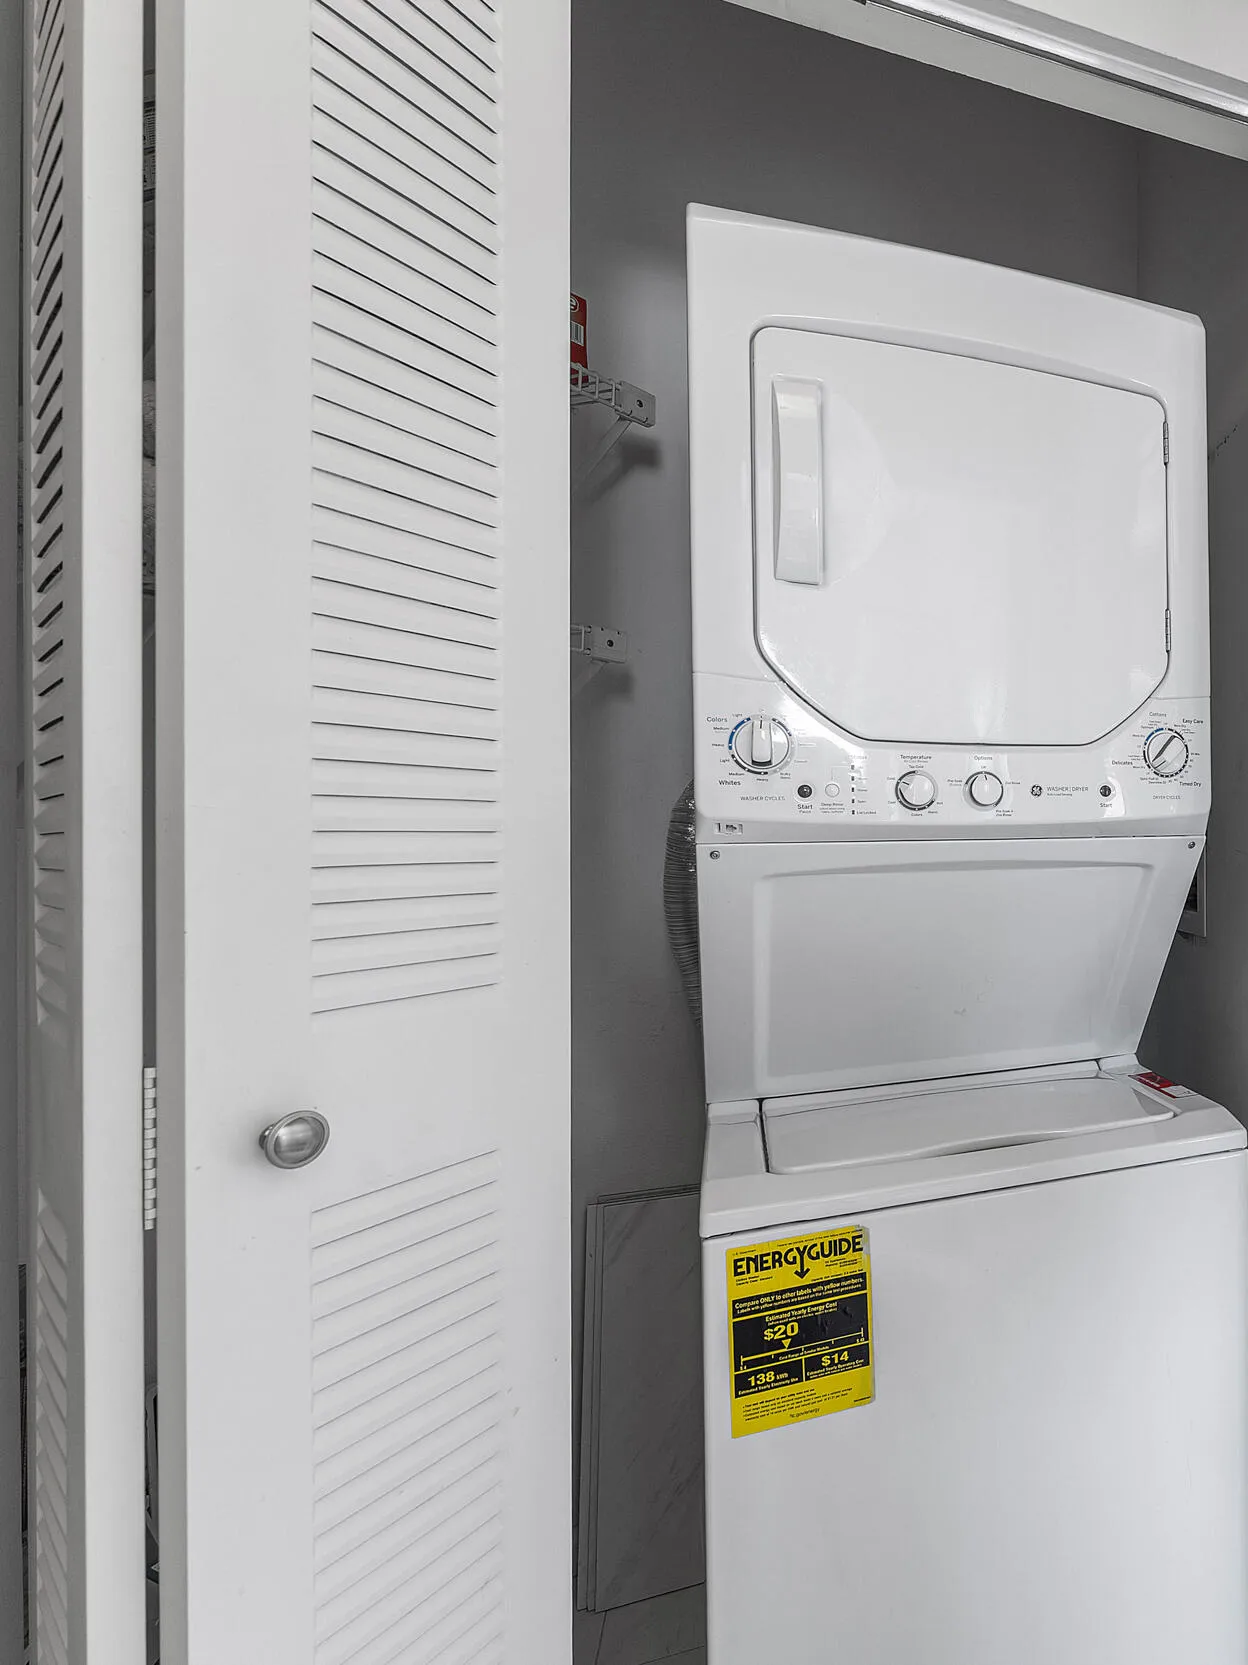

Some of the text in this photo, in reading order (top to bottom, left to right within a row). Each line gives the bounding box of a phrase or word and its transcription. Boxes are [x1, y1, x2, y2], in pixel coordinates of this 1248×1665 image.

[706, 716, 728, 724] Colors
[733, 1233, 864, 1279] ENERGYGUIDE
[734, 1299, 760, 1310] Compare
[760, 1295, 775, 1304] ONLY
[776, 1294, 783, 1302] to
[782, 1290, 797, 1300] other
[797, 1287, 812, 1296] labels
[812, 1285, 824, 1293] with
[824, 1281, 841, 1291] yellow
[765, 1300, 839, 1323] Estimated Yearly Energy Cost
[763, 1321, 799, 1342] $20
[821, 1350, 850, 1367] $14
[747, 1370, 776, 1387] 138
[738, 1387, 758, 1395] Estimated
